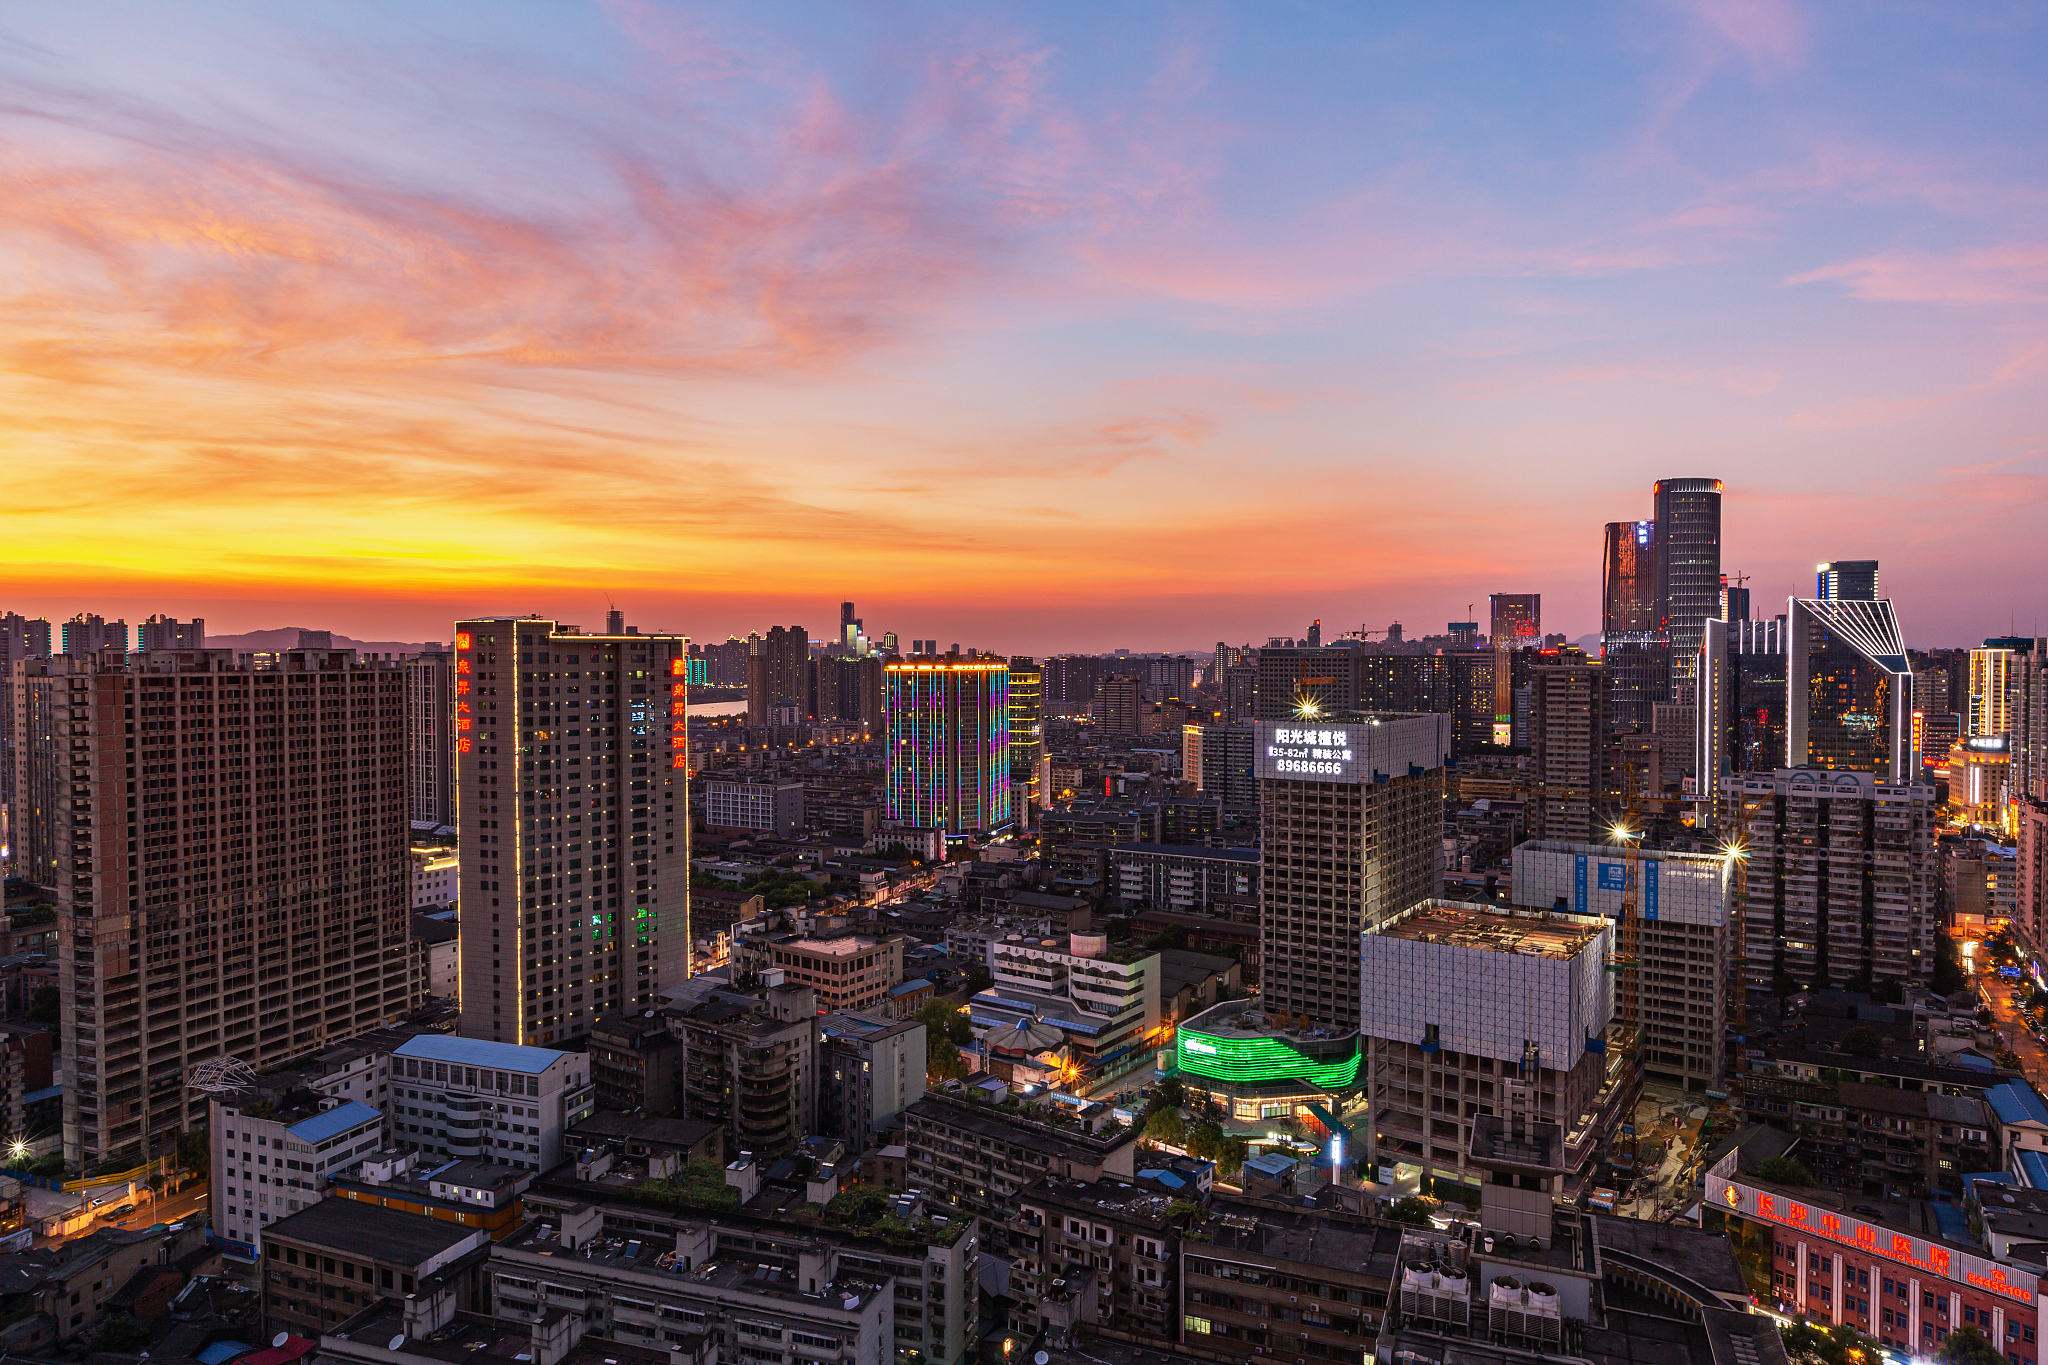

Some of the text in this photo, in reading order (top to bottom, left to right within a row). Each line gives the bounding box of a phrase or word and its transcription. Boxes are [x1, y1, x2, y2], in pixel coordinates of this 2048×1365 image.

[1276, 729, 1347, 746] 阳光城檀悦
[1277, 759, 1341, 774] 89686666
[1757, 1192, 1951, 1269] 长沙中山医院
[1967, 1272, 2032, 1302] 84455100
